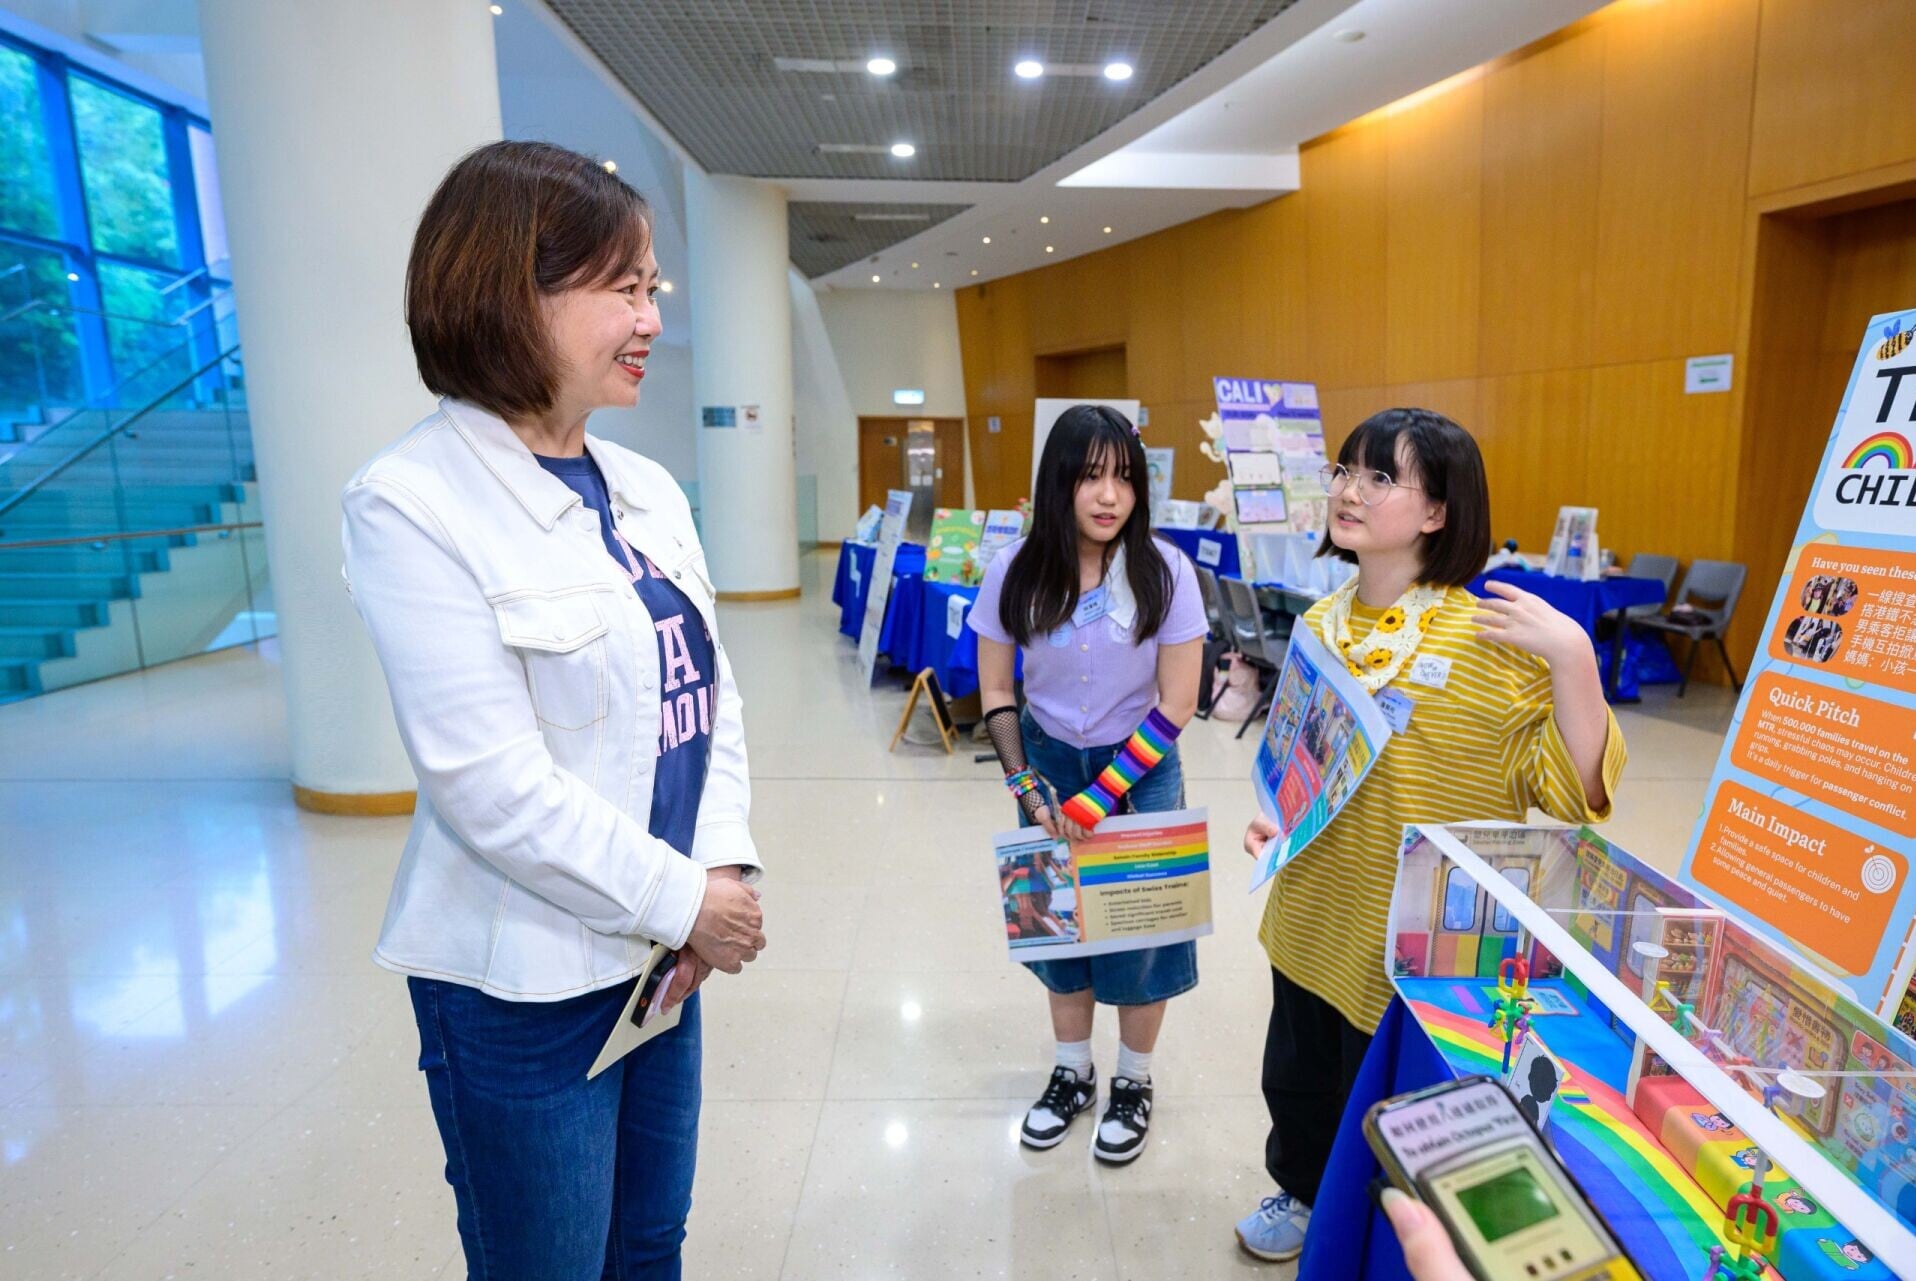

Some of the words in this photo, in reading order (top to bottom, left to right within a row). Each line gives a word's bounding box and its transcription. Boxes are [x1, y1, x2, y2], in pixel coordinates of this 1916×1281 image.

[1217, 379, 1263, 403] CALI
[1876, 365, 1916, 423] T
[1811, 557, 1838, 569] Have
[1838, 562, 1860, 574] you
[1861, 566, 1886, 576] seen
[1769, 687, 1814, 714] Quick
[1815, 699, 1861, 728] Pitch
[1749, 742, 1769, 755] grips.
[1757, 719, 1776, 732] MTR,
[1777, 727, 1811, 744] stressful
[1811, 738, 1834, 752] chaos
[1836, 747, 1854, 761] may
[1855, 754, 1881, 769] occur.
[1761, 709, 1781, 722] When
[1782, 716, 1816, 734] 500,000
[1816, 727, 1850, 746] families
[1851, 739, 1877, 755] travel
[1879, 750, 1891, 760] on
[1892, 751, 1909, 765] the
[1747, 750, 1758, 761] It's
[1764, 757, 1782, 771] daily
[1783, 764, 1809, 781] trigger
[1810, 775, 1822, 785] for
[1822, 781, 1868, 804] passenger
[1869, 798, 1907, 820] conflict.
[1754, 731, 1781, 748] running,
[1783, 742, 1817, 761] grabbing
[1844, 763, 1861, 775] and
[1862, 766, 1898, 790] hanging
[1900, 783, 1913, 794] on
[1720, 836, 1748, 857] families.
[1728, 797, 1766, 829] Main
[1766, 815, 1827, 857] Impact
[1100, 888, 1131, 897] Impacts
[1712, 855, 1731, 871] some
[1731, 865, 1750, 881] peace
[1752, 875, 1766, 890] and
[1766, 883, 1788, 903] quiet.
[1745, 861, 1774, 881] general
[1774, 875, 1818, 907] passengers
[1820, 901, 1829, 912] to
[1829, 906, 1851, 923] have
[1754, 840, 1771, 856] safe
[1771, 851, 1794, 868] space
[1795, 861, 1807, 872] for
[1807, 869, 1841, 892] children
[1841, 884, 1860, 901] and
